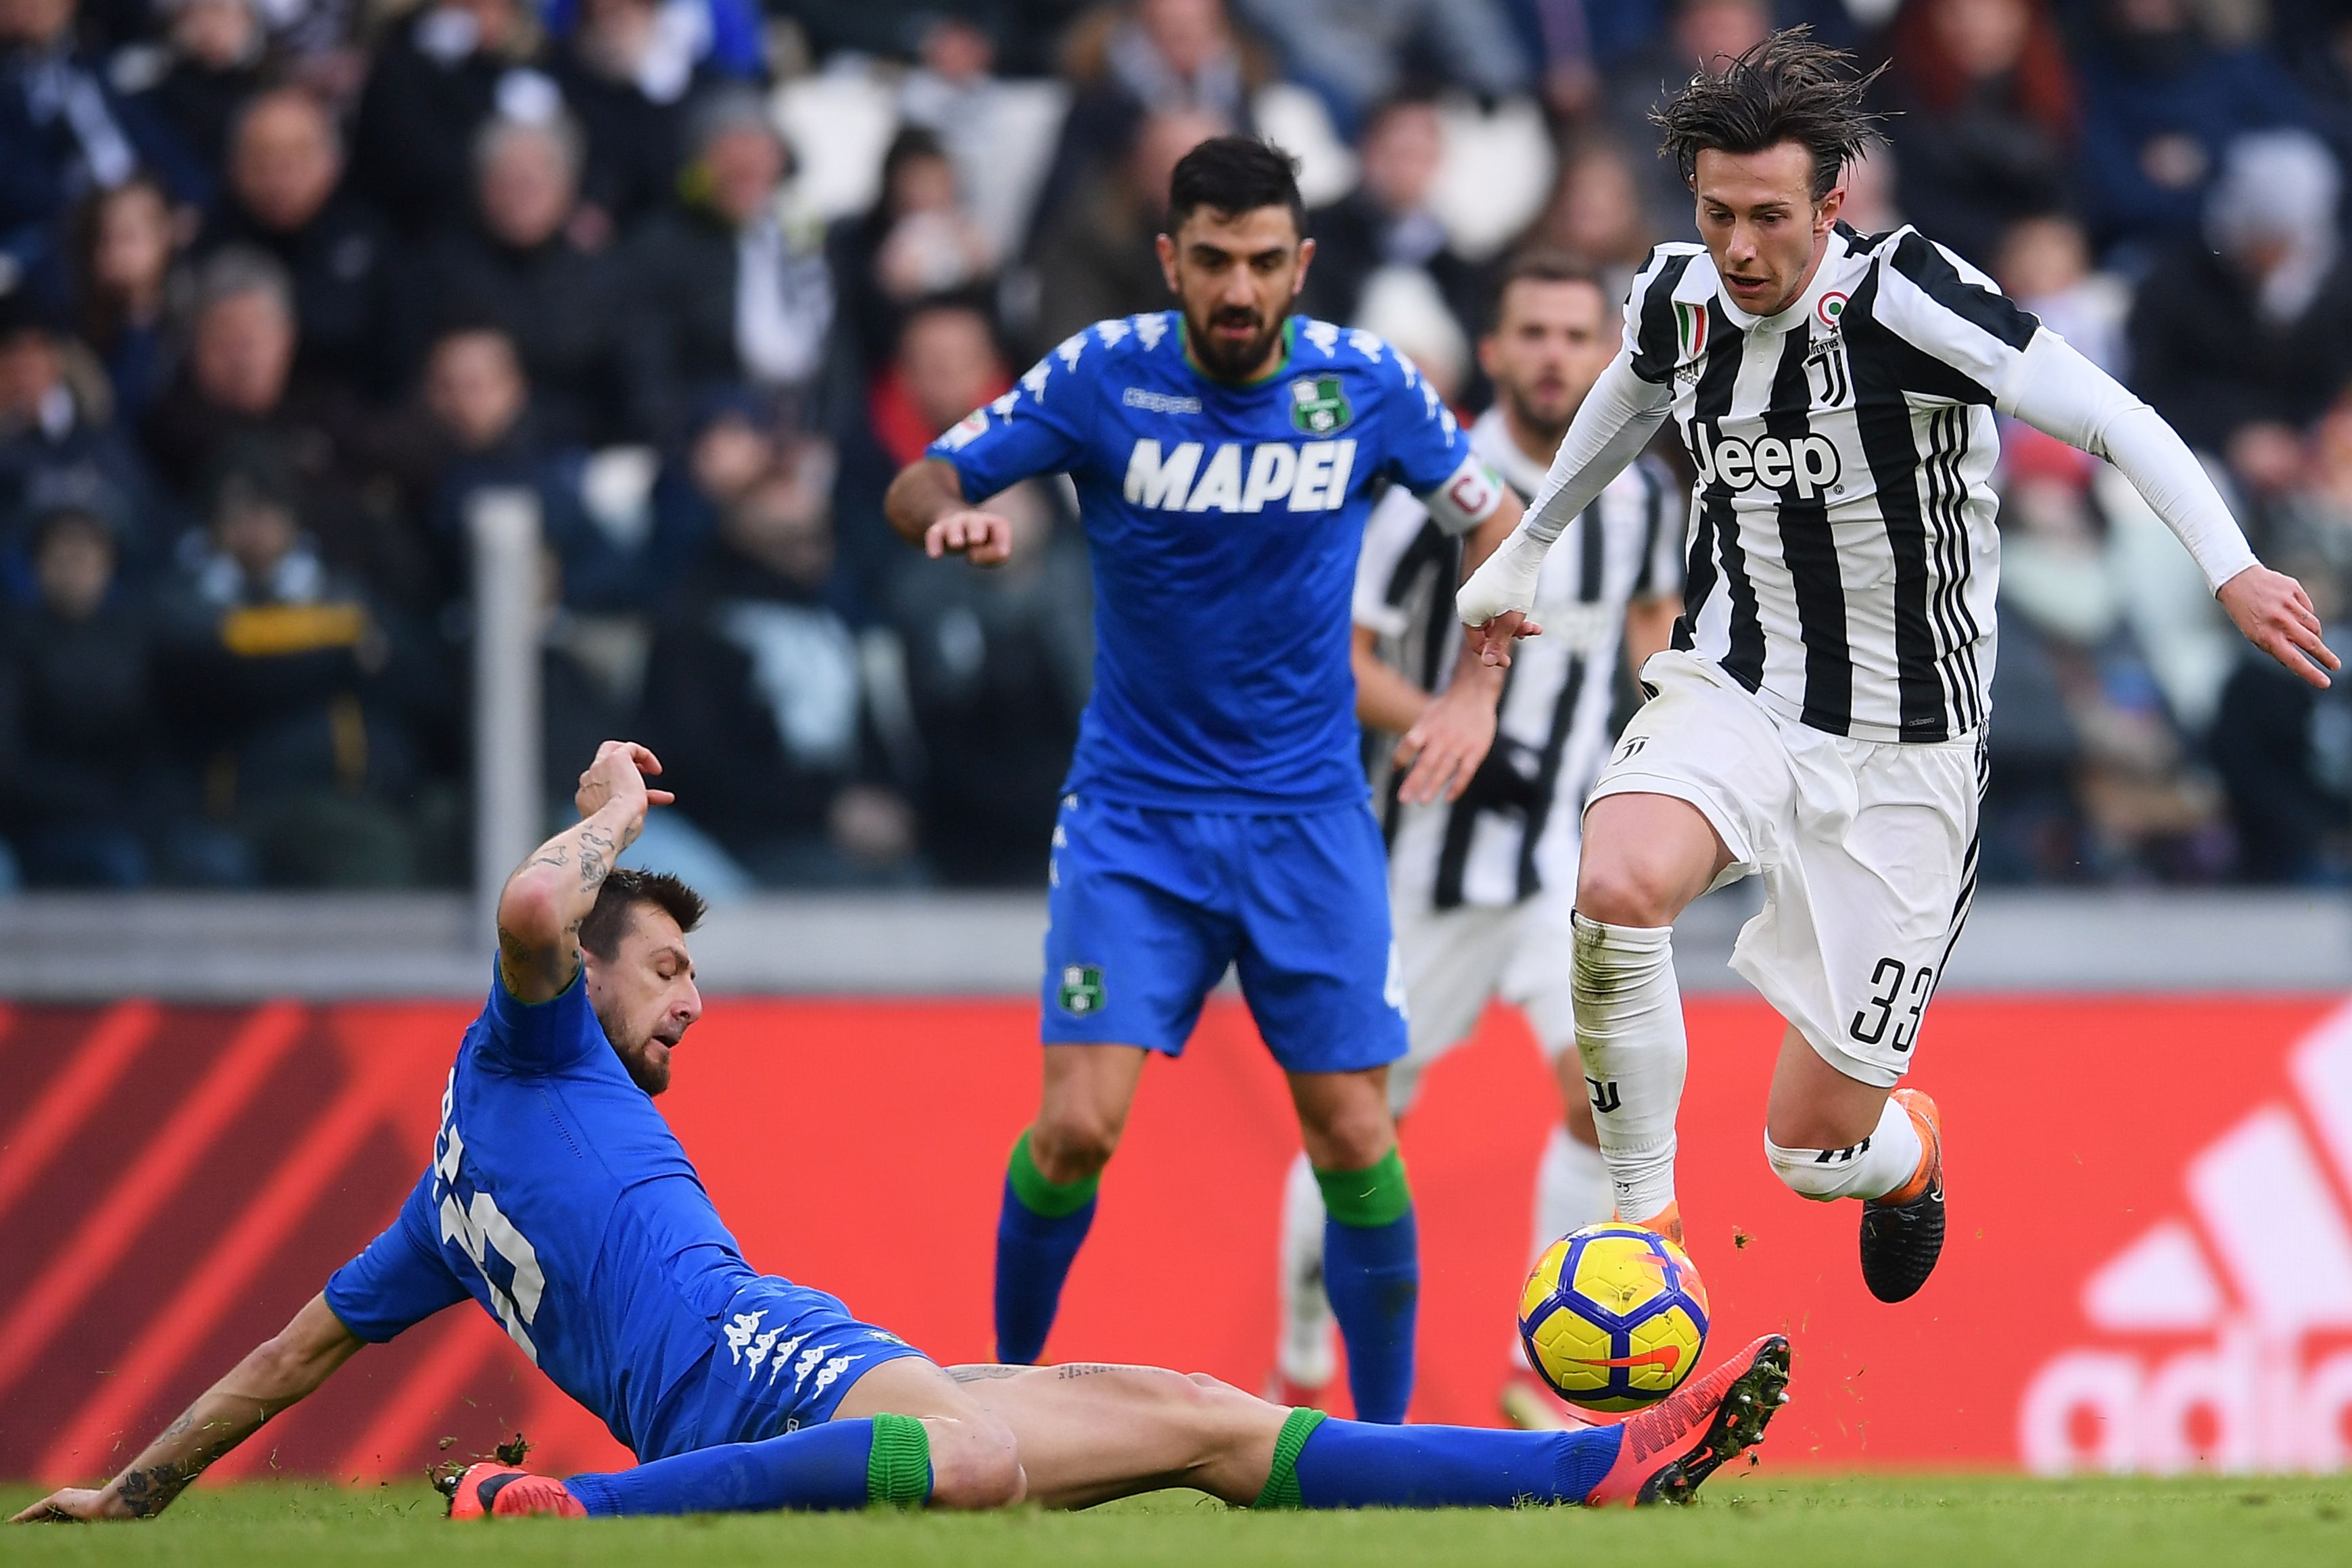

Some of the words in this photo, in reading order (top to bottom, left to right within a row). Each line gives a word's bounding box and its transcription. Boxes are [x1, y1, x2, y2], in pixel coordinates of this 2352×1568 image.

[1676, 369, 1698, 387] adida
[1123, 438, 1357, 513] MAPEI
[1449, 475, 1488, 515] C
[1695, 421, 1839, 500] Jeep
[1850, 957, 1933, 1053] 33
